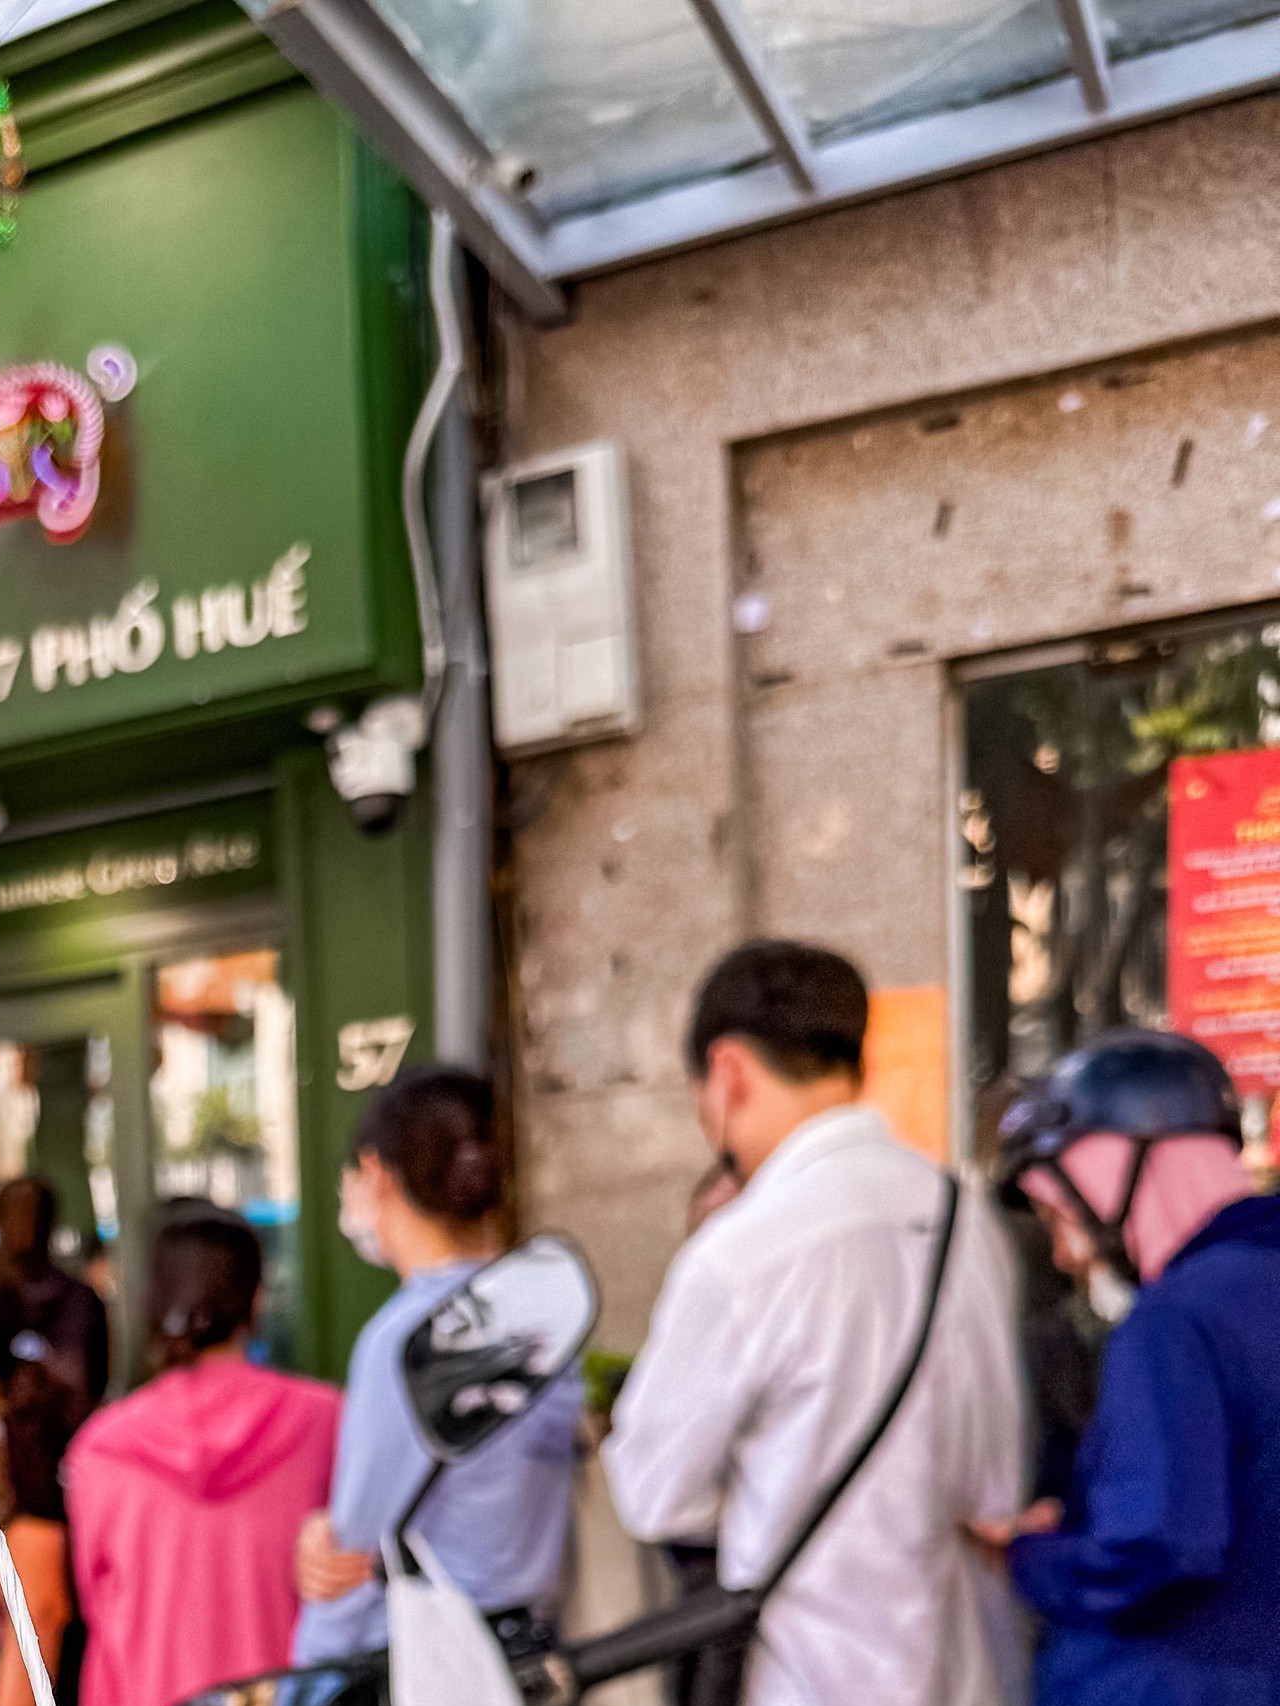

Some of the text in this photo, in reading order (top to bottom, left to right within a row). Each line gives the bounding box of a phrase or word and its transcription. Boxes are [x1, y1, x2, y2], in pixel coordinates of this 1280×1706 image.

[30, 577, 166, 692] PHỐ
[173, 541, 311, 659] HUẾ
[336, 1016, 416, 1091] 57
